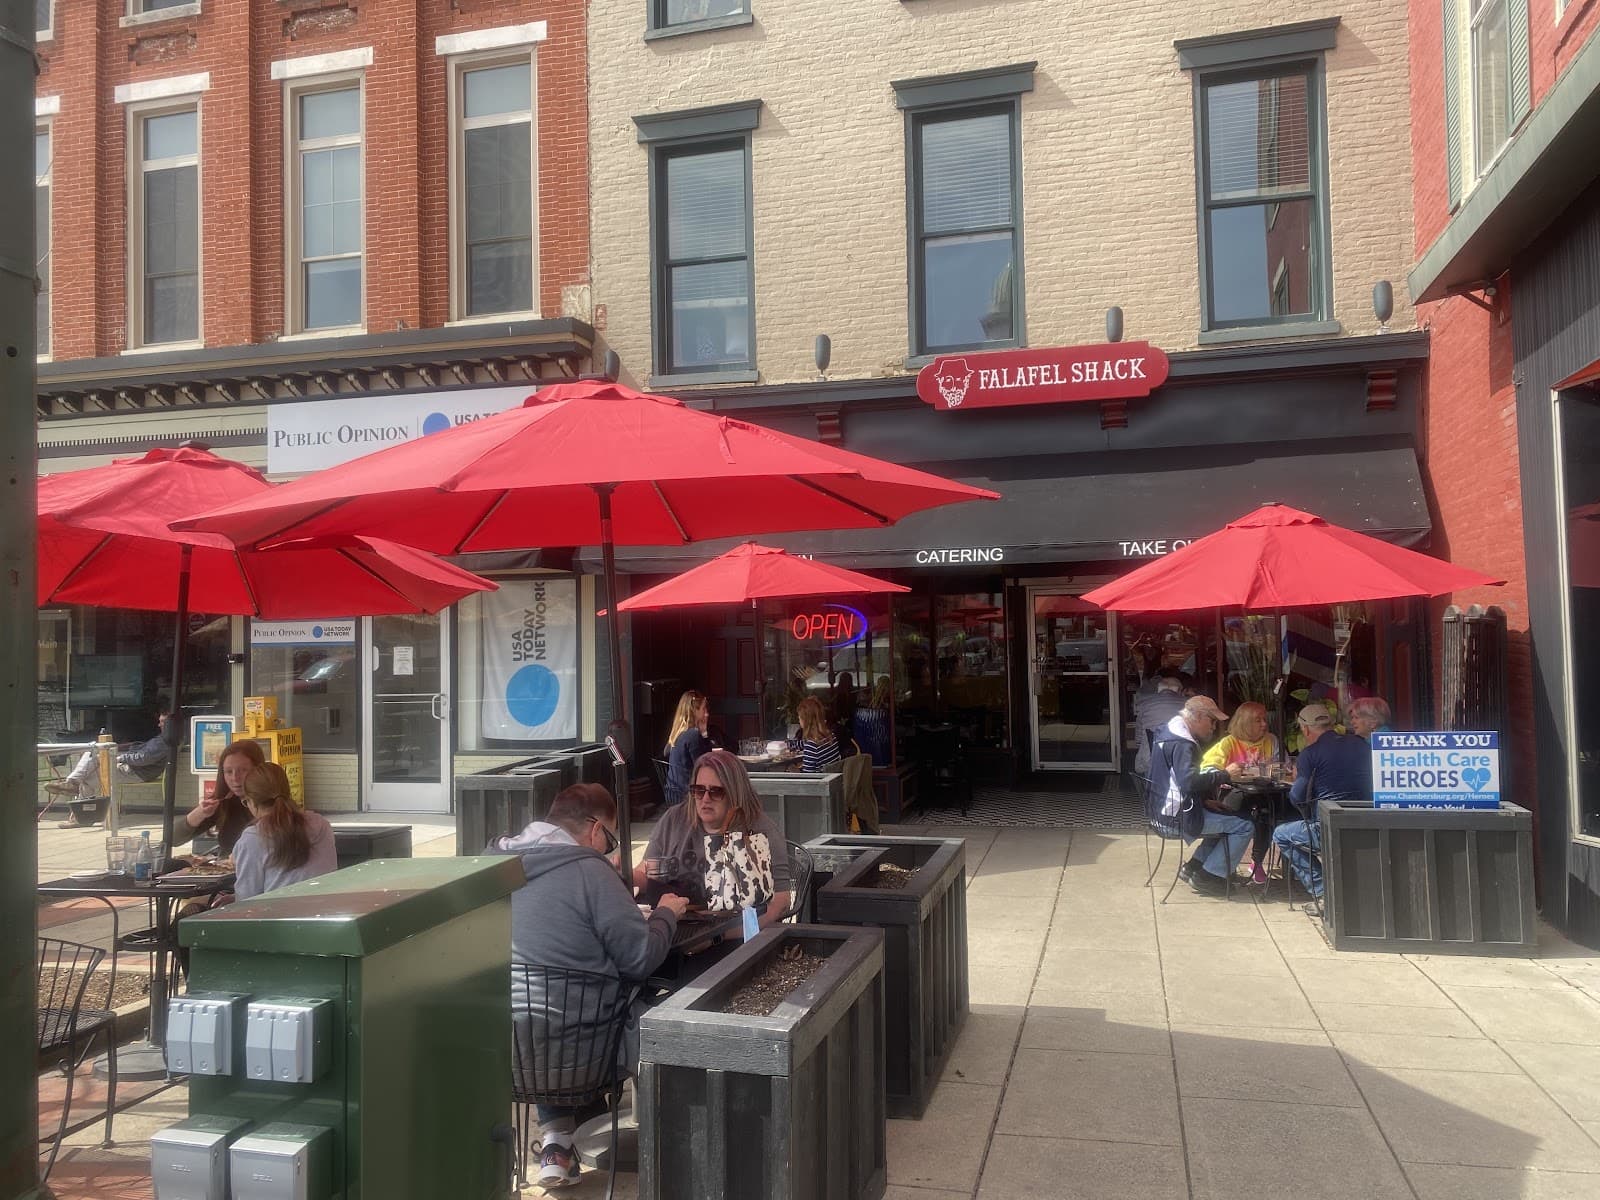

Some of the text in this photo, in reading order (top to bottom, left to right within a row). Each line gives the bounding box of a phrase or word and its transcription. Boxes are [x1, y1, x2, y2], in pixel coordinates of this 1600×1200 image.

[978, 357, 1147, 390] FALAFEL SHACK
[273, 424, 409, 448] PUBLIC OPINION
[916, 547, 1004, 564] CATERING
[1118, 540, 1168, 556] TAKE
[534, 581, 546, 660] NETWORK
[792, 613, 853, 640] OPEN
[254, 628, 306, 638] PUBLIC OPINION
[522, 608, 535, 662] TODAY
[512, 630, 522, 661] USA
[277, 733, 297, 746] PUBLIC
[1378, 734, 1492, 748] THANK YOU
[279, 744, 301, 757] OPINION
[1380, 751, 1491, 767] Health Care
[1380, 769, 1459, 788] HEROES
